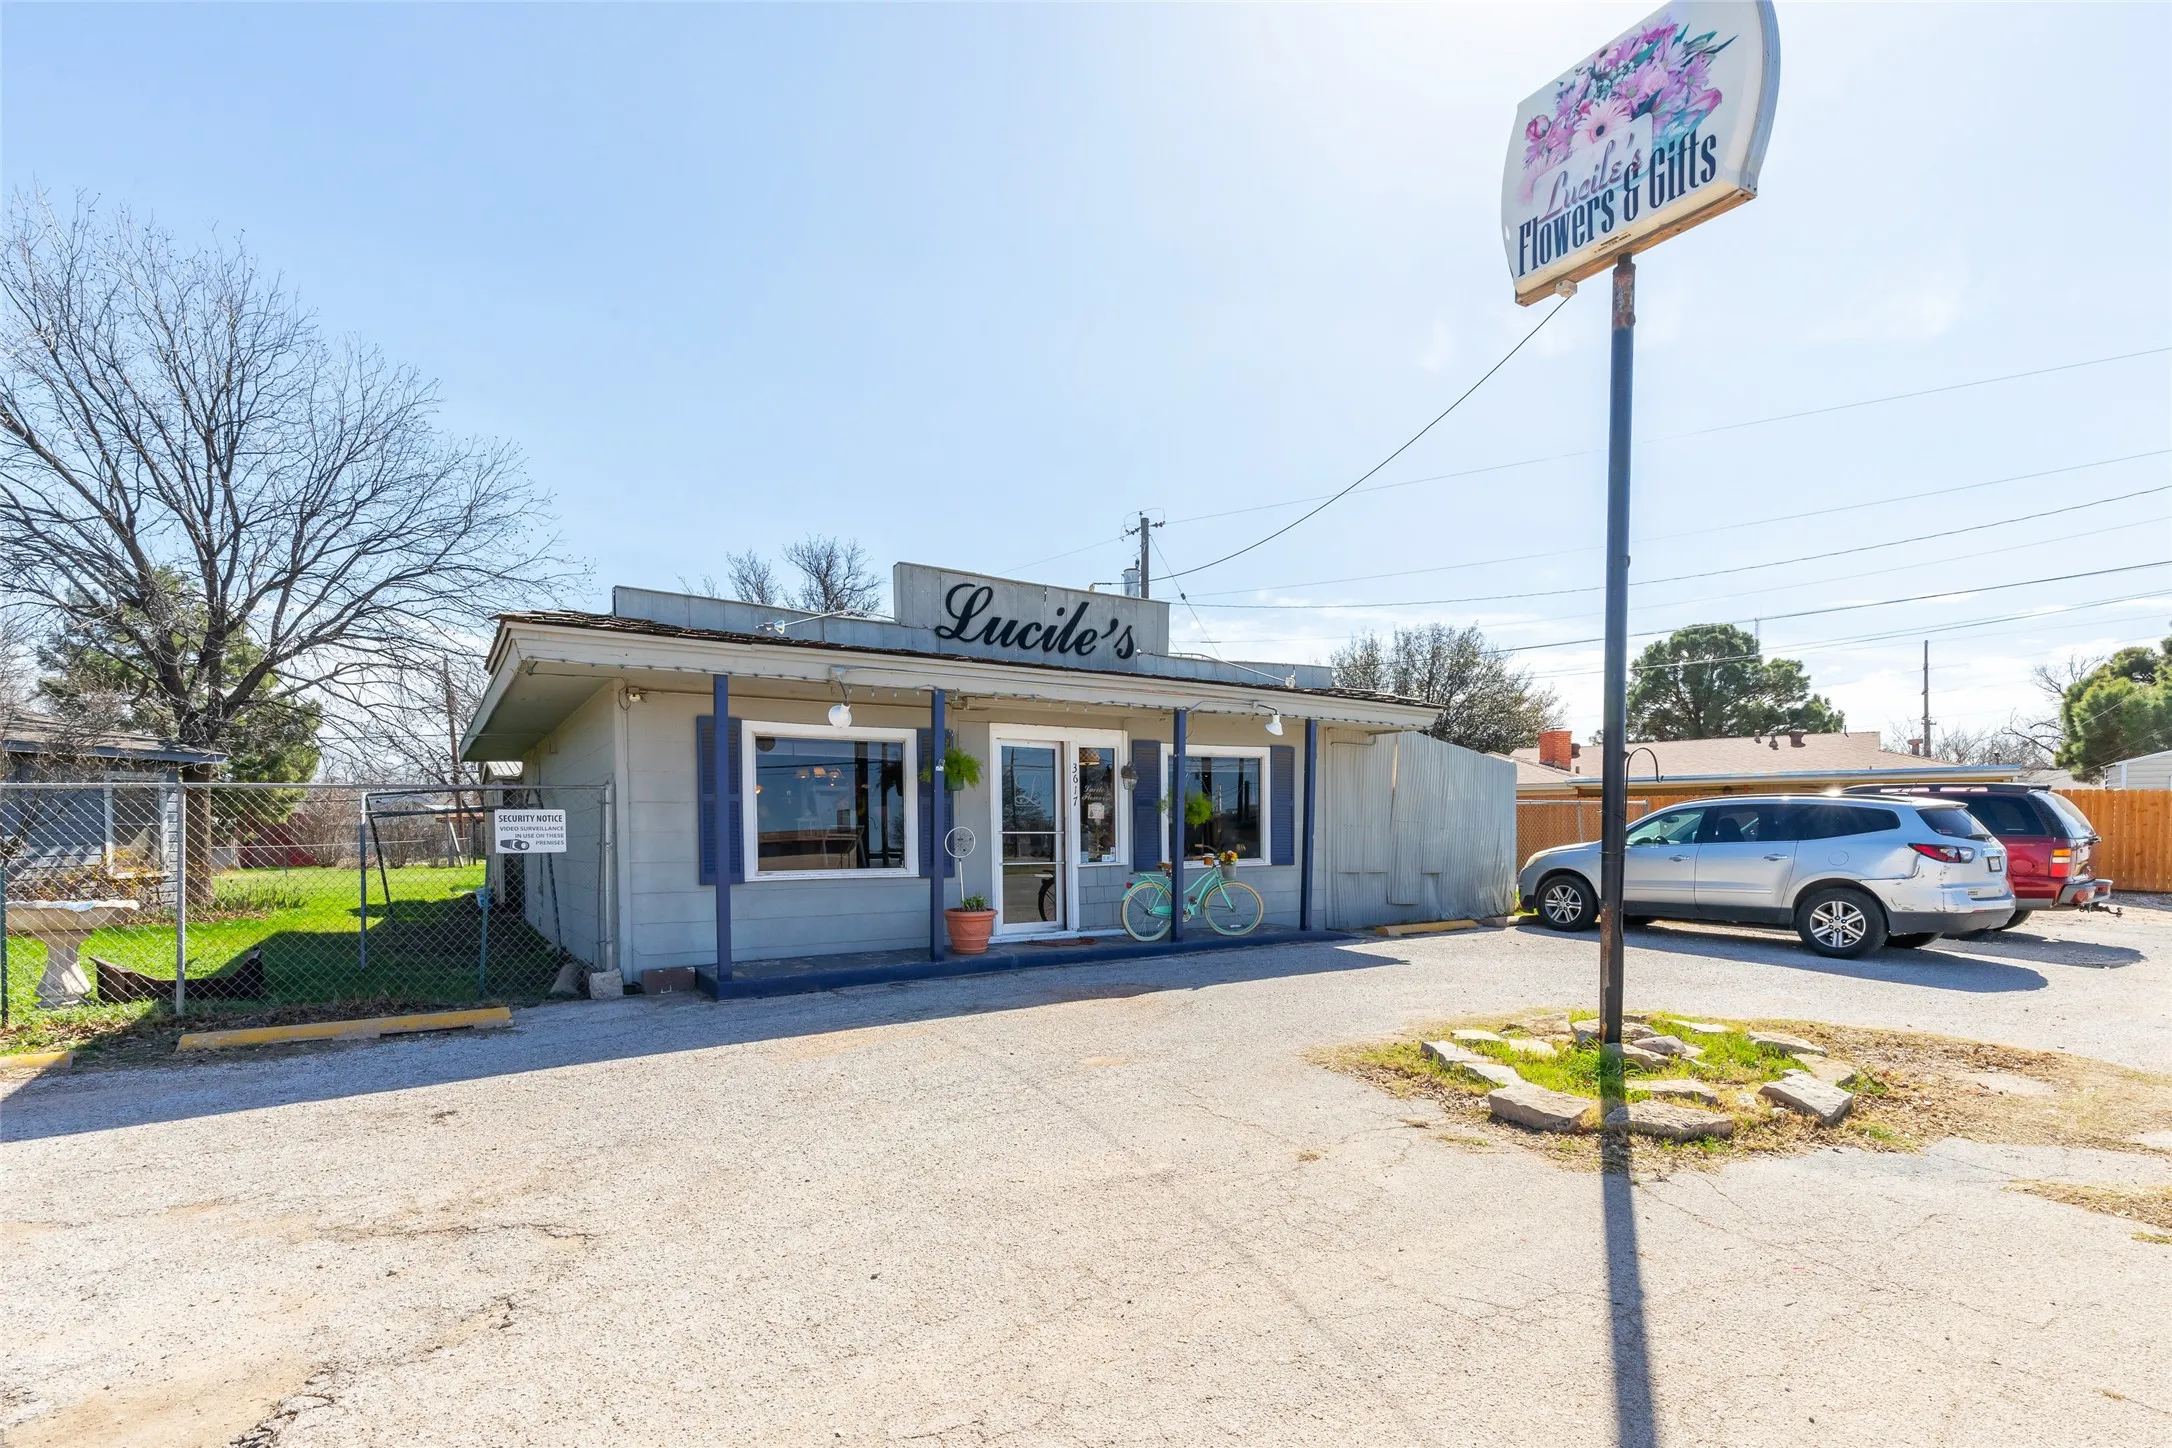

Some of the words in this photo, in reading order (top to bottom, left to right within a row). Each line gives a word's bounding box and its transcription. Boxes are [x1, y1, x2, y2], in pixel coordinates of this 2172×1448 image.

[1518, 187, 1615, 277] Flowers
[1623, 161, 1640, 222] &
[1650, 129, 1717, 209] Gifts
[1538, 132, 1641, 223] Lucile's
[935, 583, 1134, 659] Lucile's
[498, 814, 535, 823] SECURITY
[536, 814, 563, 823] NOTICE
